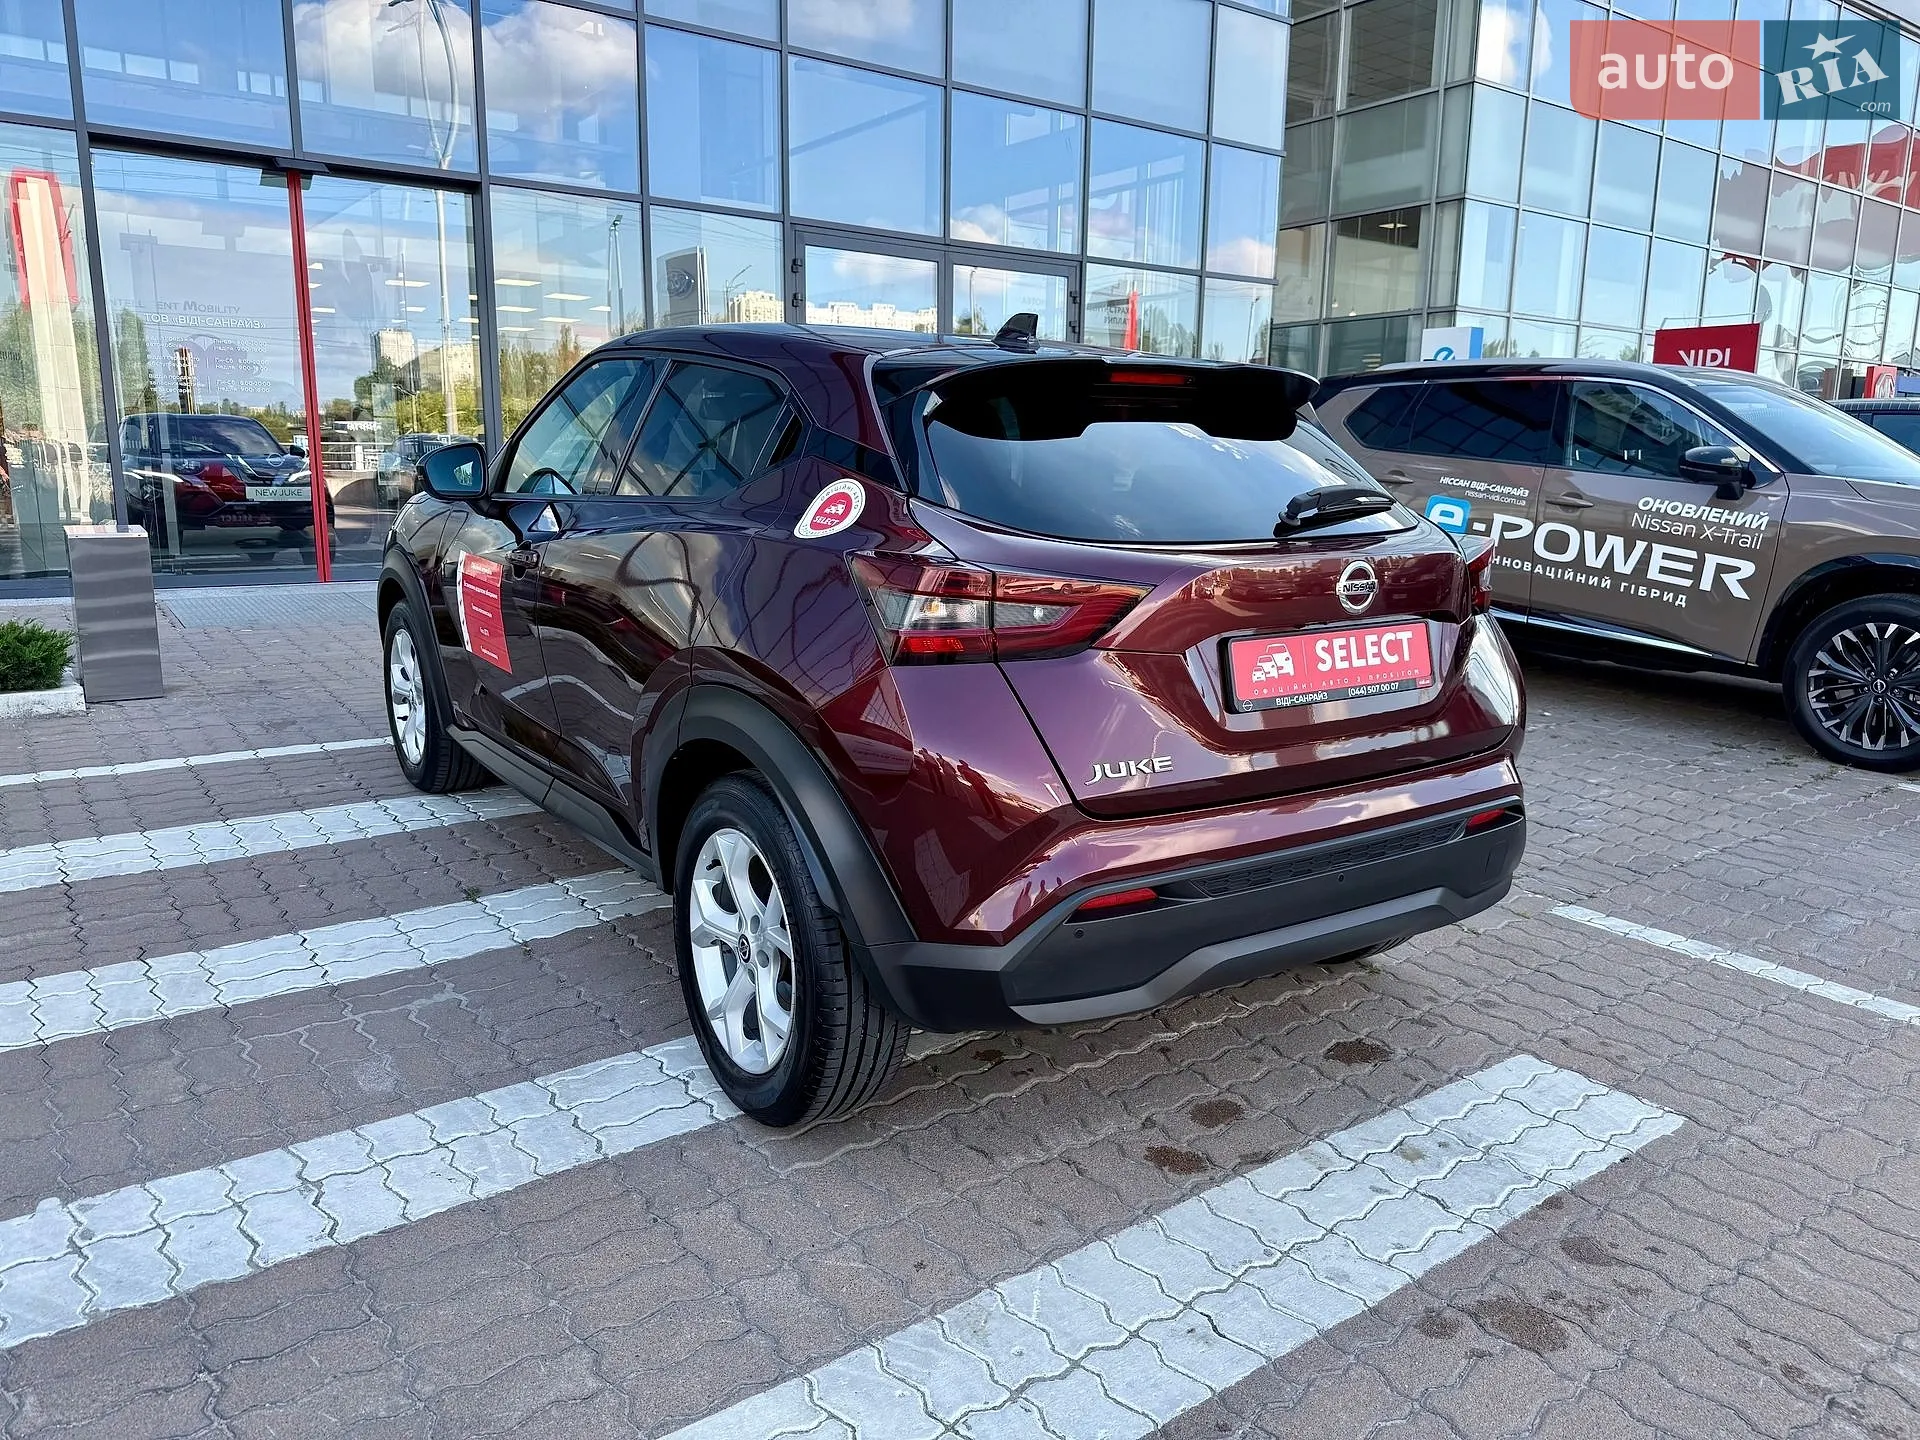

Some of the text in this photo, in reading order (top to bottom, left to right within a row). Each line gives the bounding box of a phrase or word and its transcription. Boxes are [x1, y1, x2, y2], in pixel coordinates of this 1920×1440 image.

[144, 312, 169, 323] ТОВ
[1678, 348, 1731, 367] VIDI
[1440, 476, 1471, 488] НІССАН
[255, 489, 303, 497] NEW JUKE
[813, 515, 840, 527] SELECT
[1638, 497, 1770, 531] ОНОВЛЕНИЙ
[1632, 512, 1763, 550] Nissan X-Trail
[1342, 580, 1376, 593] NISSAN
[1491, 555, 1688, 608] ННОВАЦІЙНИЙ ГІБРИД
[1314, 630, 1413, 672] SELECT
[1348, 682, 1399, 697] (044) 507 00 07
[1276, 691, 1328, 706] ВІДІ-САНРАЙЗ
[1084, 755, 1174, 786] JUKE
